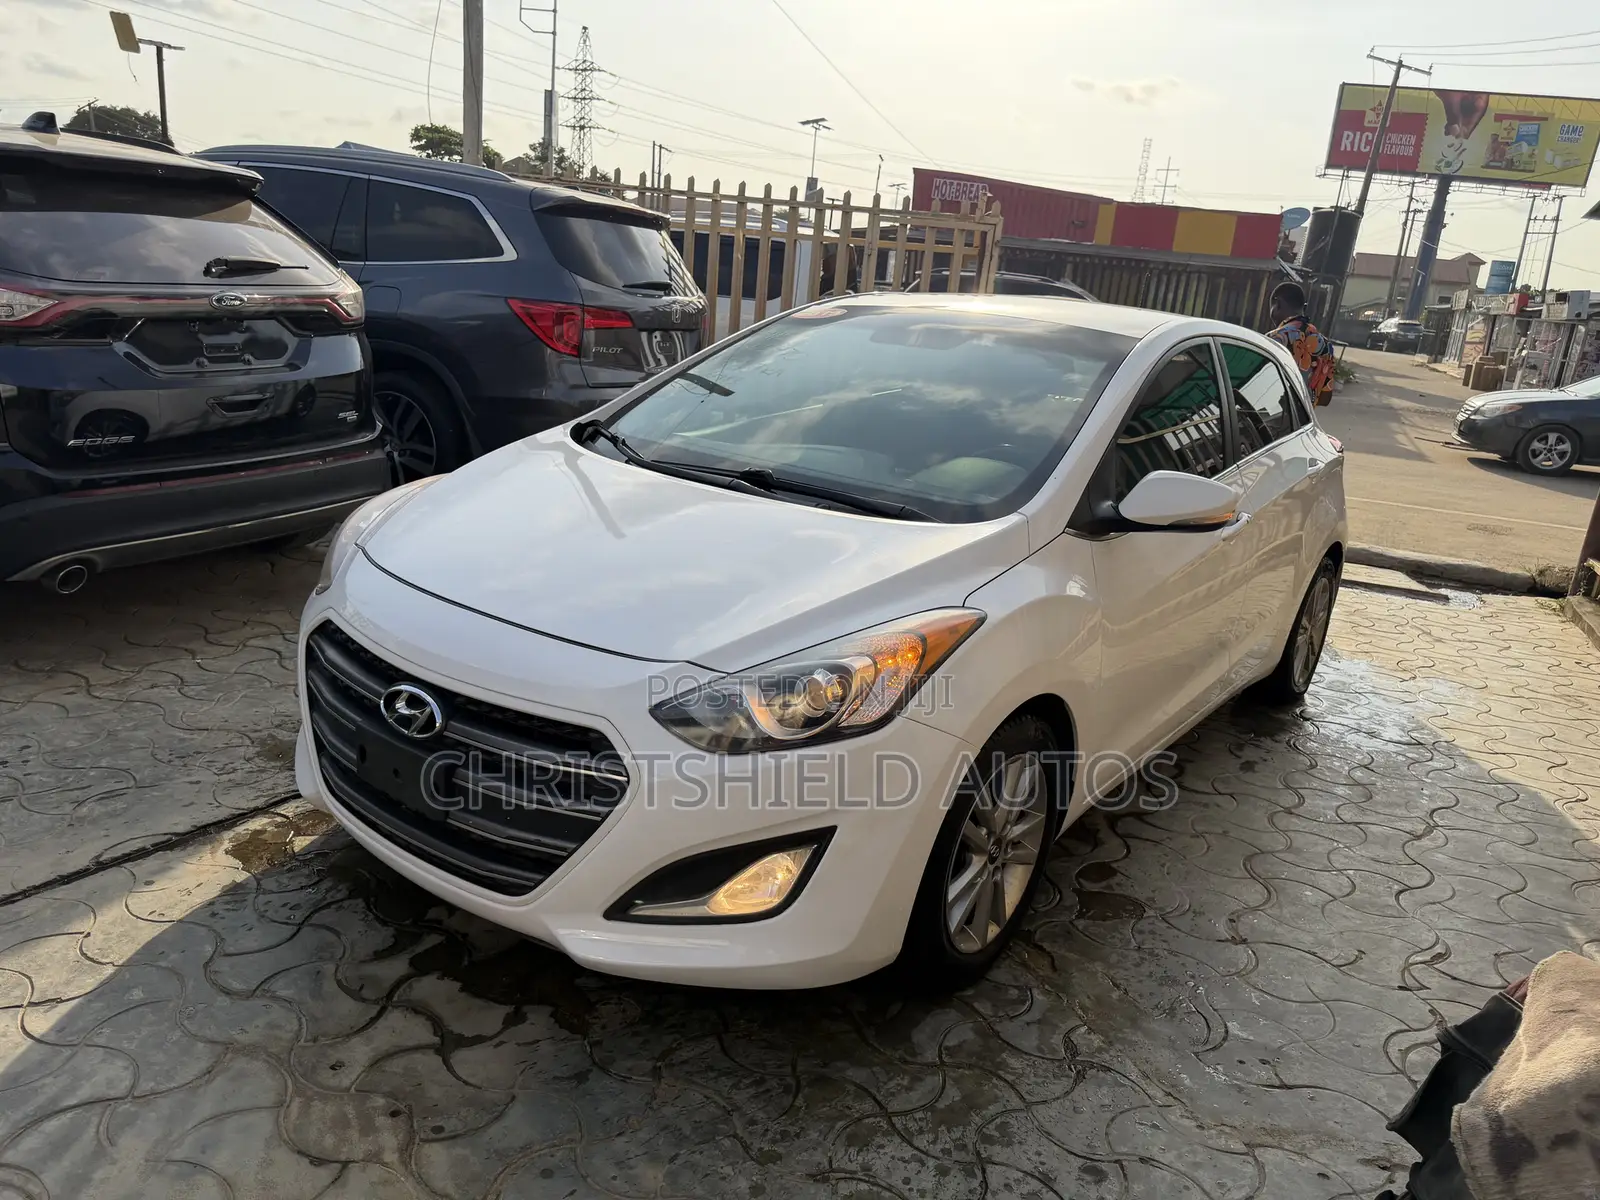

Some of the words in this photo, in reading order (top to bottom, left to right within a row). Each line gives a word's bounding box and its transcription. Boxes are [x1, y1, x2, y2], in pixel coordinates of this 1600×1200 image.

[1386, 132, 1417, 146] CHICKEN
[1383, 143, 1414, 156] FLAVOUR
[221, 295, 241, 306] Ford
[592, 346, 624, 354] PILOT
[67, 435, 136, 447] EDGE
